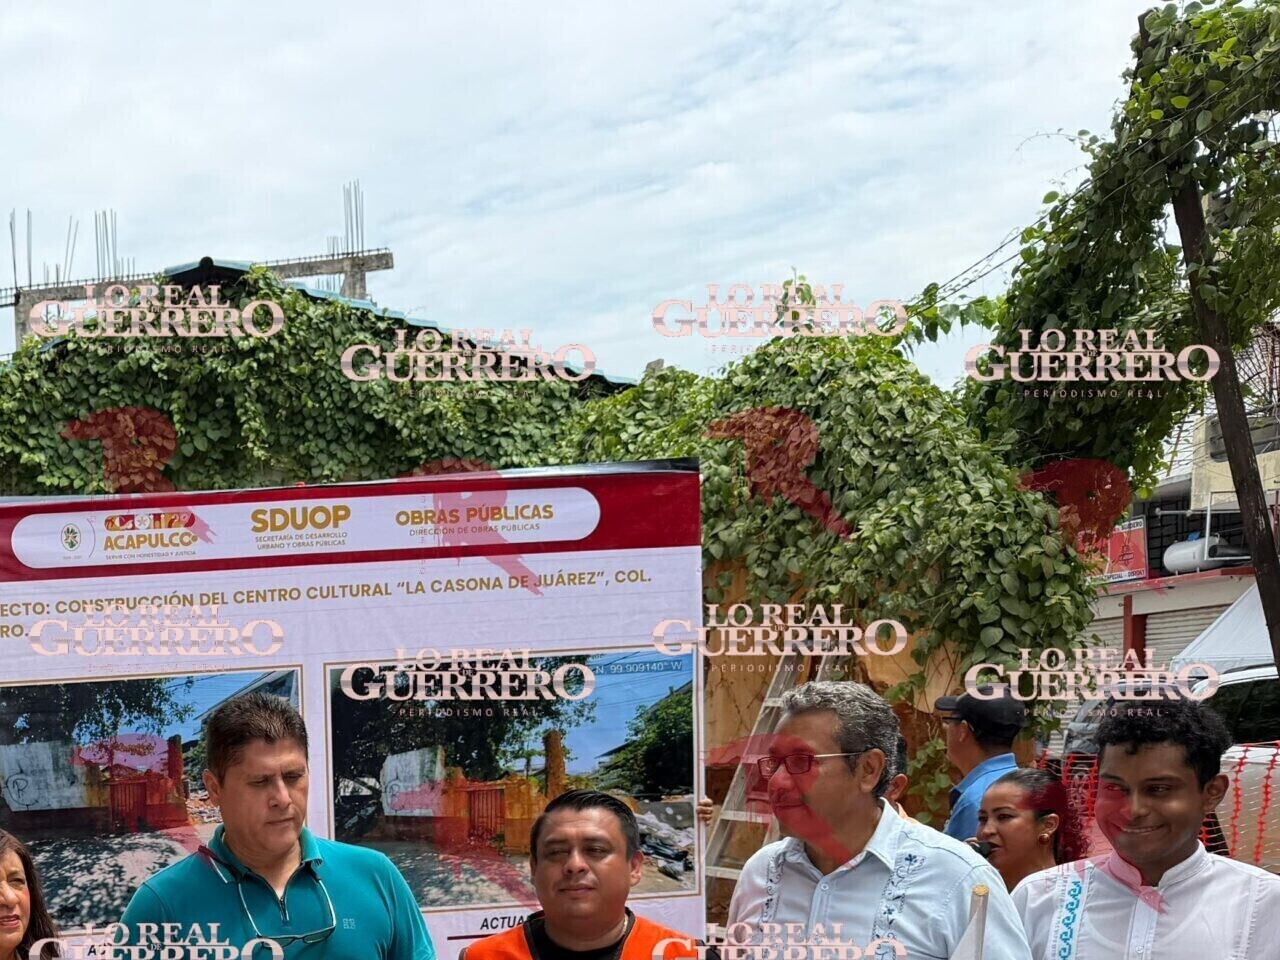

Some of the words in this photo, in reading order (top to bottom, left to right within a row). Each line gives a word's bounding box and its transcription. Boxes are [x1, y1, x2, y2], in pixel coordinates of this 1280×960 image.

[251, 505, 351, 533] SDUOP
[395, 508, 460, 526] OBRAS
[466, 504, 554, 523] PÚBLICAS
[409, 527, 455, 537] DIRECCIÓN
[457, 526, 469, 534] DE
[471, 525, 499, 534] OBRAS
[501, 522, 541, 532] PÚBLICAS
[255, 533, 293, 543] SECRETARÍA
[305, 532, 348, 540] DESARROLLO
[257, 542, 285, 551] URBANO
[315, 539, 346, 547] PÚBLICAS
[54, 591, 195, 615] CONSTRUCCIÓN
[199, 591, 229, 607] DEL
[232, 587, 302, 604] CENTRO
[306, 583, 393, 600] CULTURAL
[430, 576, 504, 593] CASONA
[508, 575, 529, 589] DE
[614, 569, 652, 583] COL.
[670, 661, 683, 670] W
